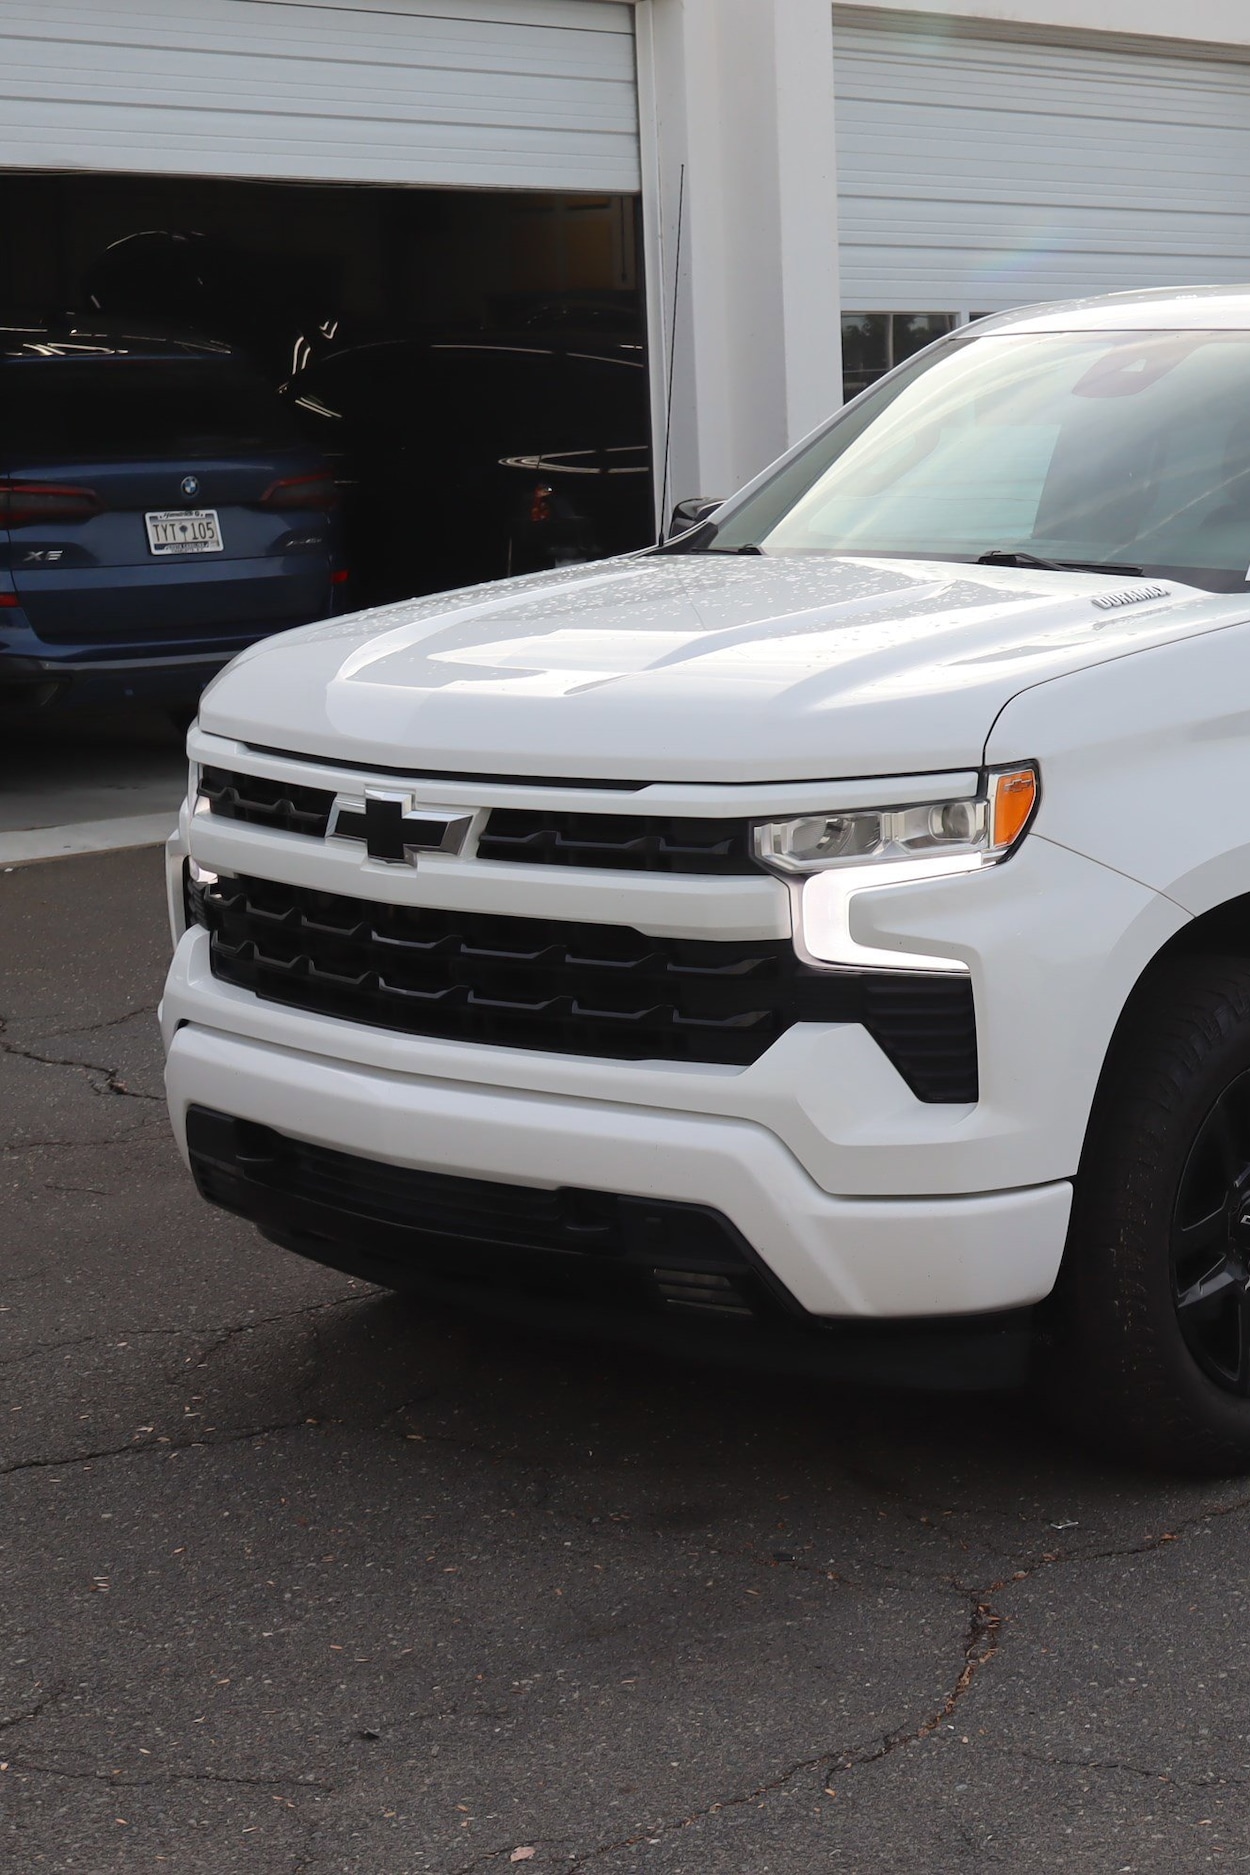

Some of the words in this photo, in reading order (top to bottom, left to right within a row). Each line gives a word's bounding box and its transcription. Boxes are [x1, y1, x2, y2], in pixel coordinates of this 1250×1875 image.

[153, 523, 176, 542] TYT
[191, 522, 215, 540] 105
[1091, 584, 1172, 609] DURAMAX
